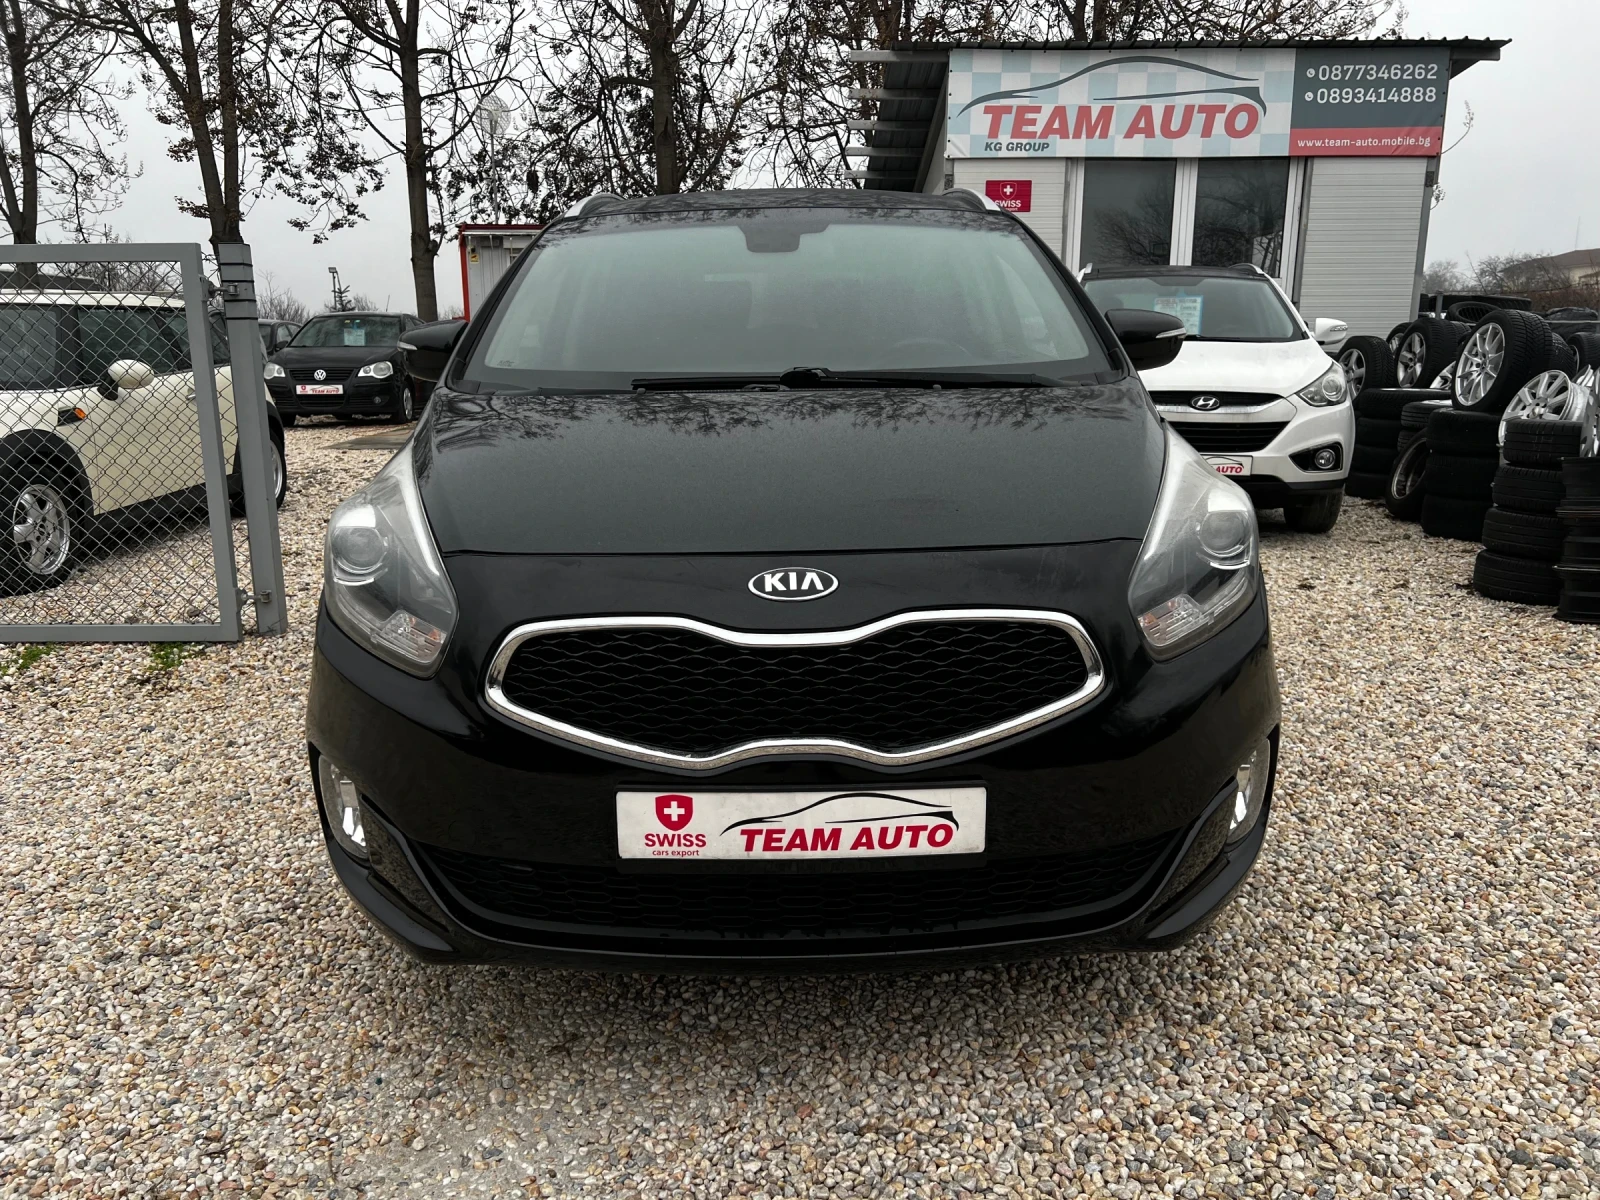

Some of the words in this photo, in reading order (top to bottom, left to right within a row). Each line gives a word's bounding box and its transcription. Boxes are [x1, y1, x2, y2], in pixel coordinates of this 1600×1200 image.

[1318, 63, 1438, 81] 0877346262
[1316, 86, 1437, 104] 0893414888
[983, 104, 1115, 140] TEAM
[1123, 103, 1259, 140] AUTO
[984, 141, 1002, 152] KG
[1005, 141, 1050, 152] GROUP
[1297, 136, 1431, 147] www.team-auto.mobile.bg
[1216, 466, 1243, 474] AUTO
[764, 572, 825, 592] KIA
[644, 833, 707, 848] SWISS
[740, 828, 844, 852] TEAM
[851, 823, 954, 851] AUTO
